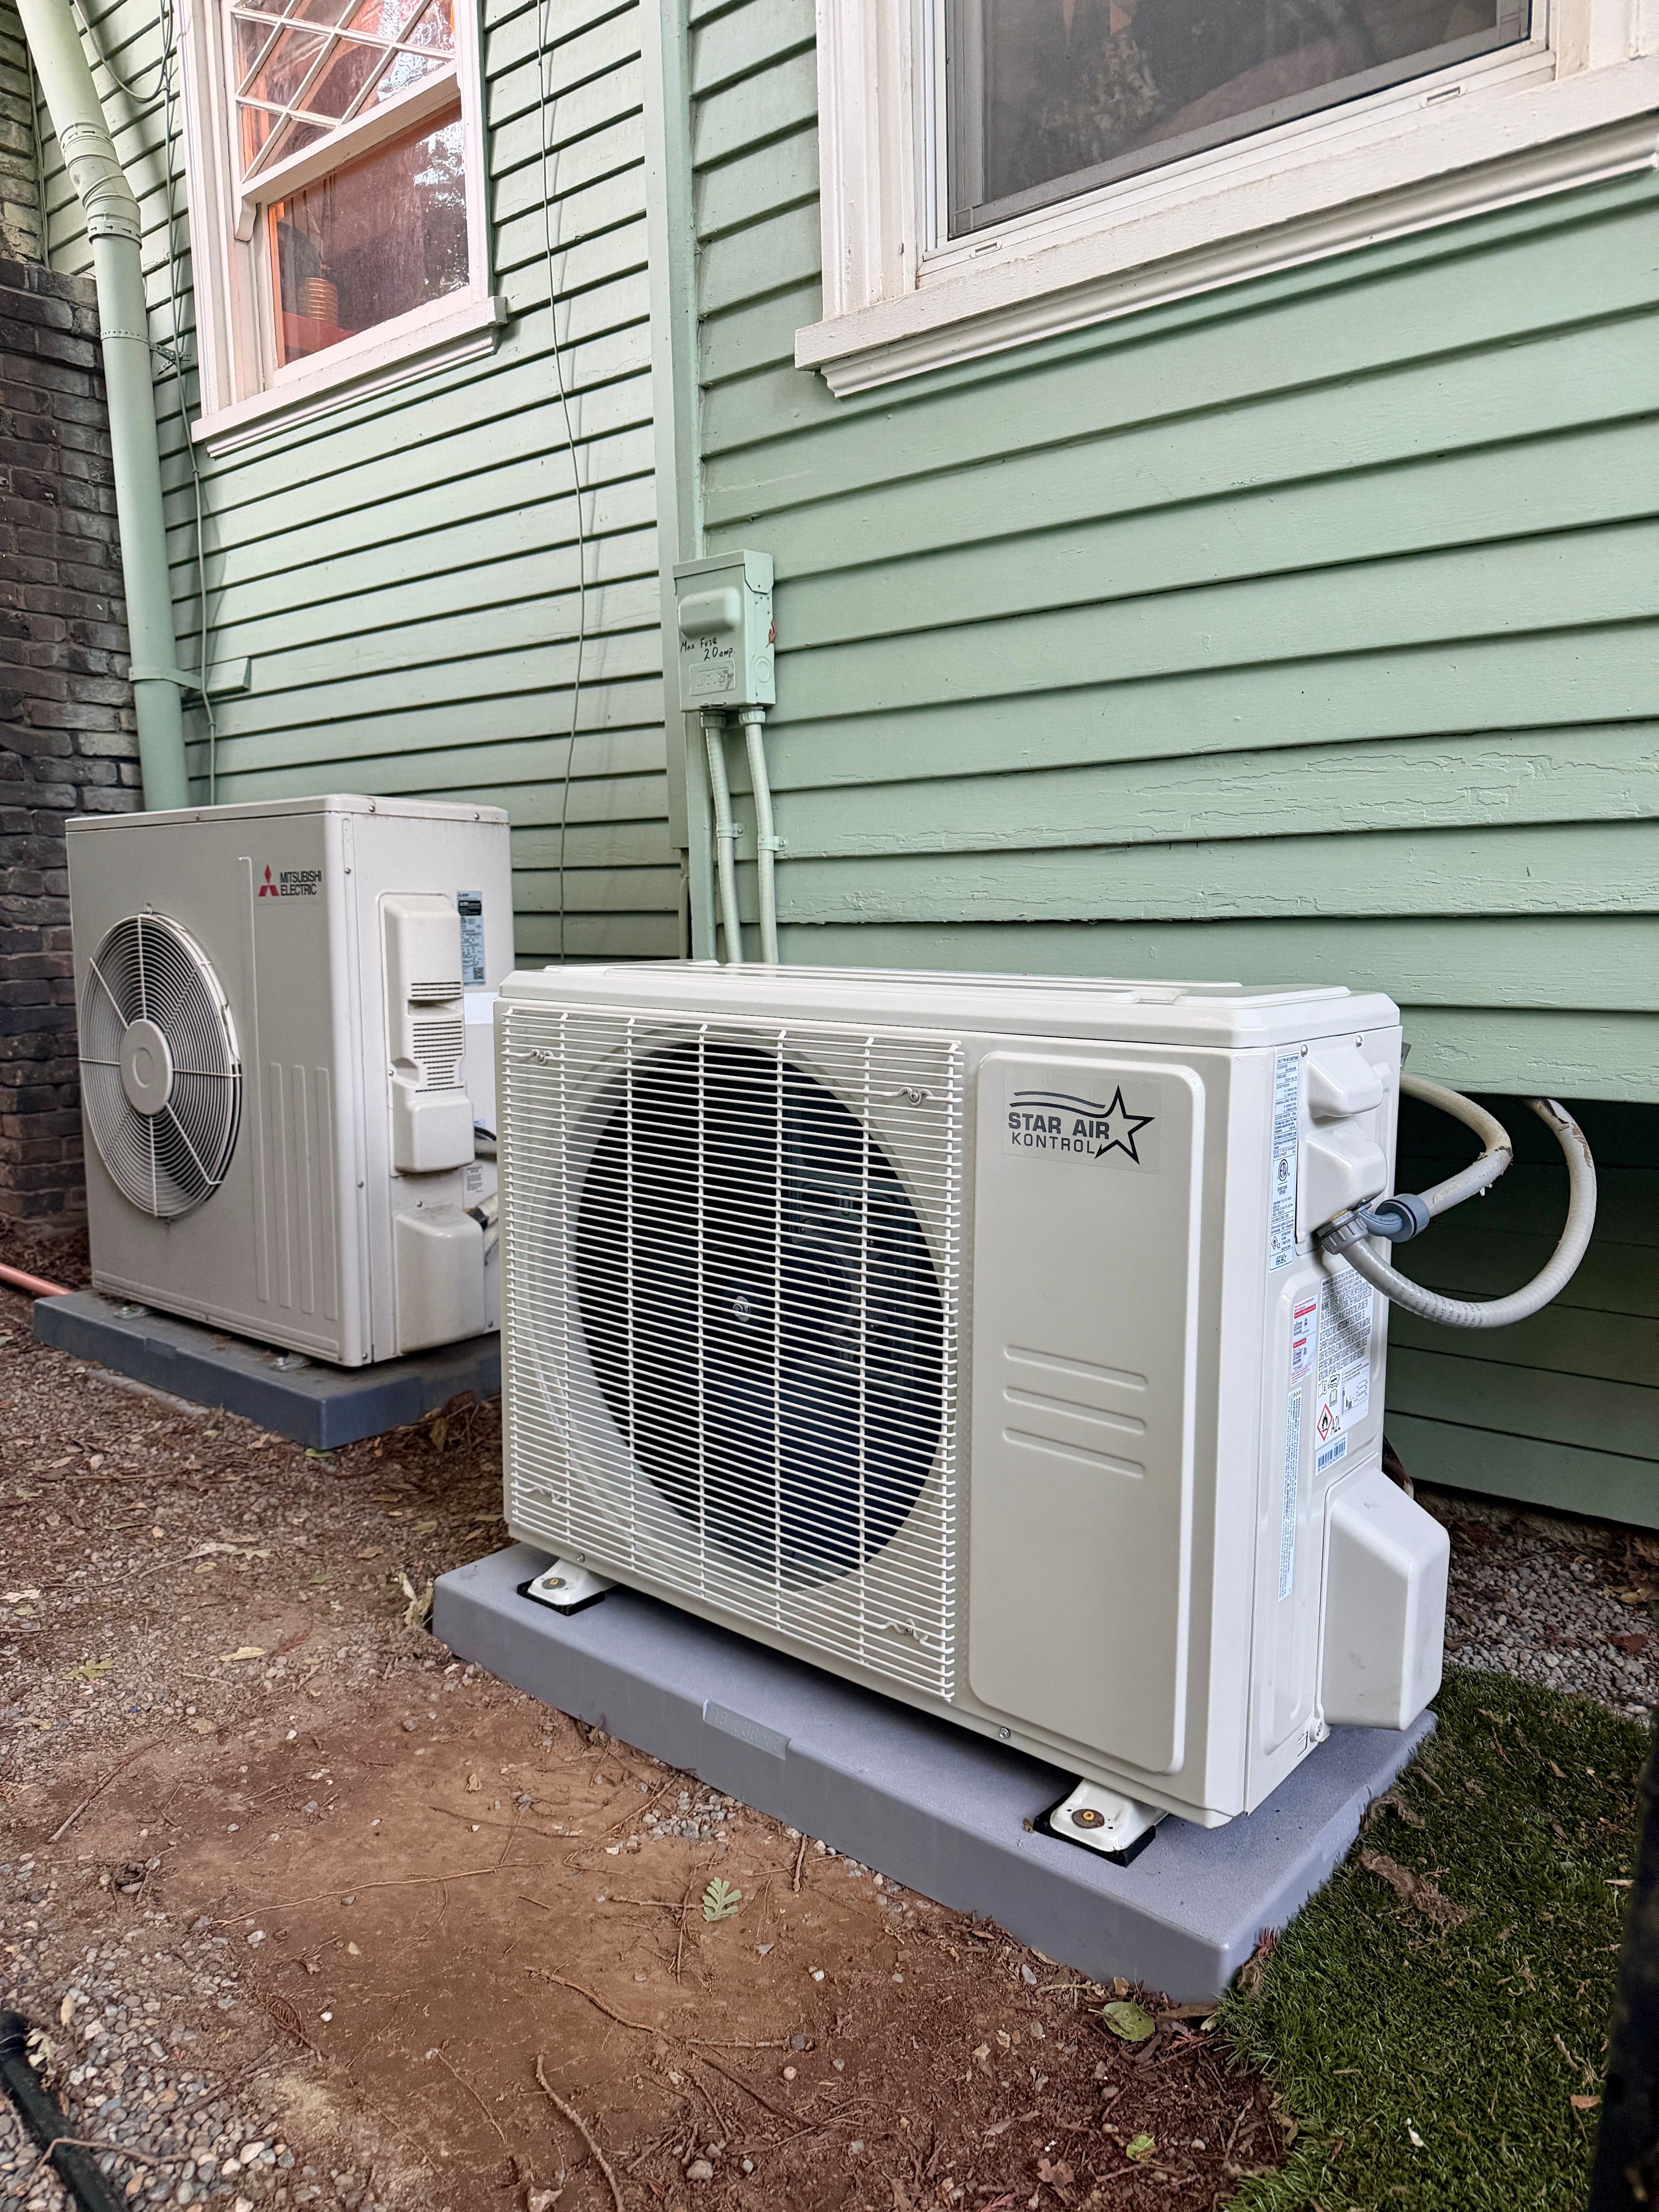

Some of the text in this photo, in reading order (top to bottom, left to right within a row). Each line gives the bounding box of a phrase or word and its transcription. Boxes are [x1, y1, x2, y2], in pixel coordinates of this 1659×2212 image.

[680, 637, 717, 653] Max Fuse
[280, 870, 322, 883] MITSUBISHI
[280, 884, 317, 896] ELECTRIC
[1008, 1112, 1110, 1140] STAR AIR
[1012, 1132, 1095, 1154] KONTROL
[1331, 1414, 1341, 1435] A2L
